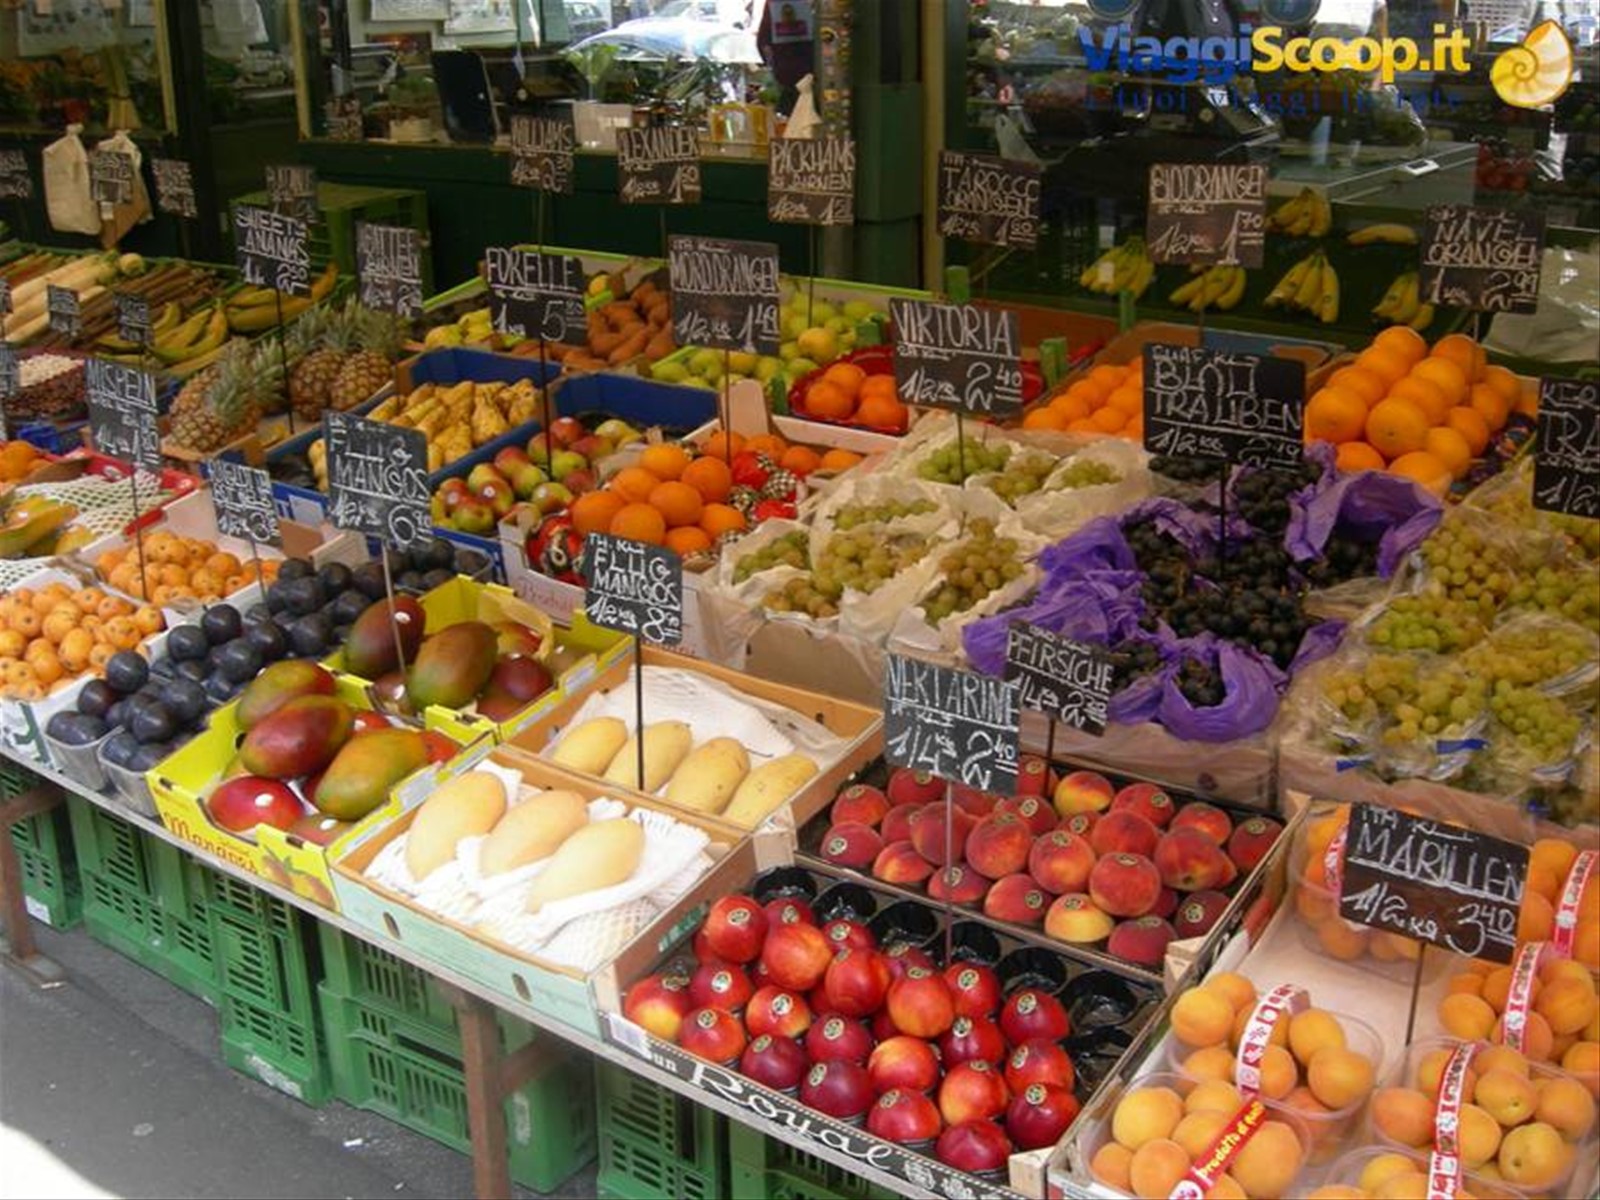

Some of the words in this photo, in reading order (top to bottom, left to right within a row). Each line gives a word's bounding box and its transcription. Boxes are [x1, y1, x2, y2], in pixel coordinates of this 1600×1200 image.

[485, 247, 577, 291] FORELLE
[890, 301, 1013, 357] VIKTORIA
[1008, 629, 1114, 695] PFIRSICHE
[1355, 822, 1526, 900] MARILLEN
